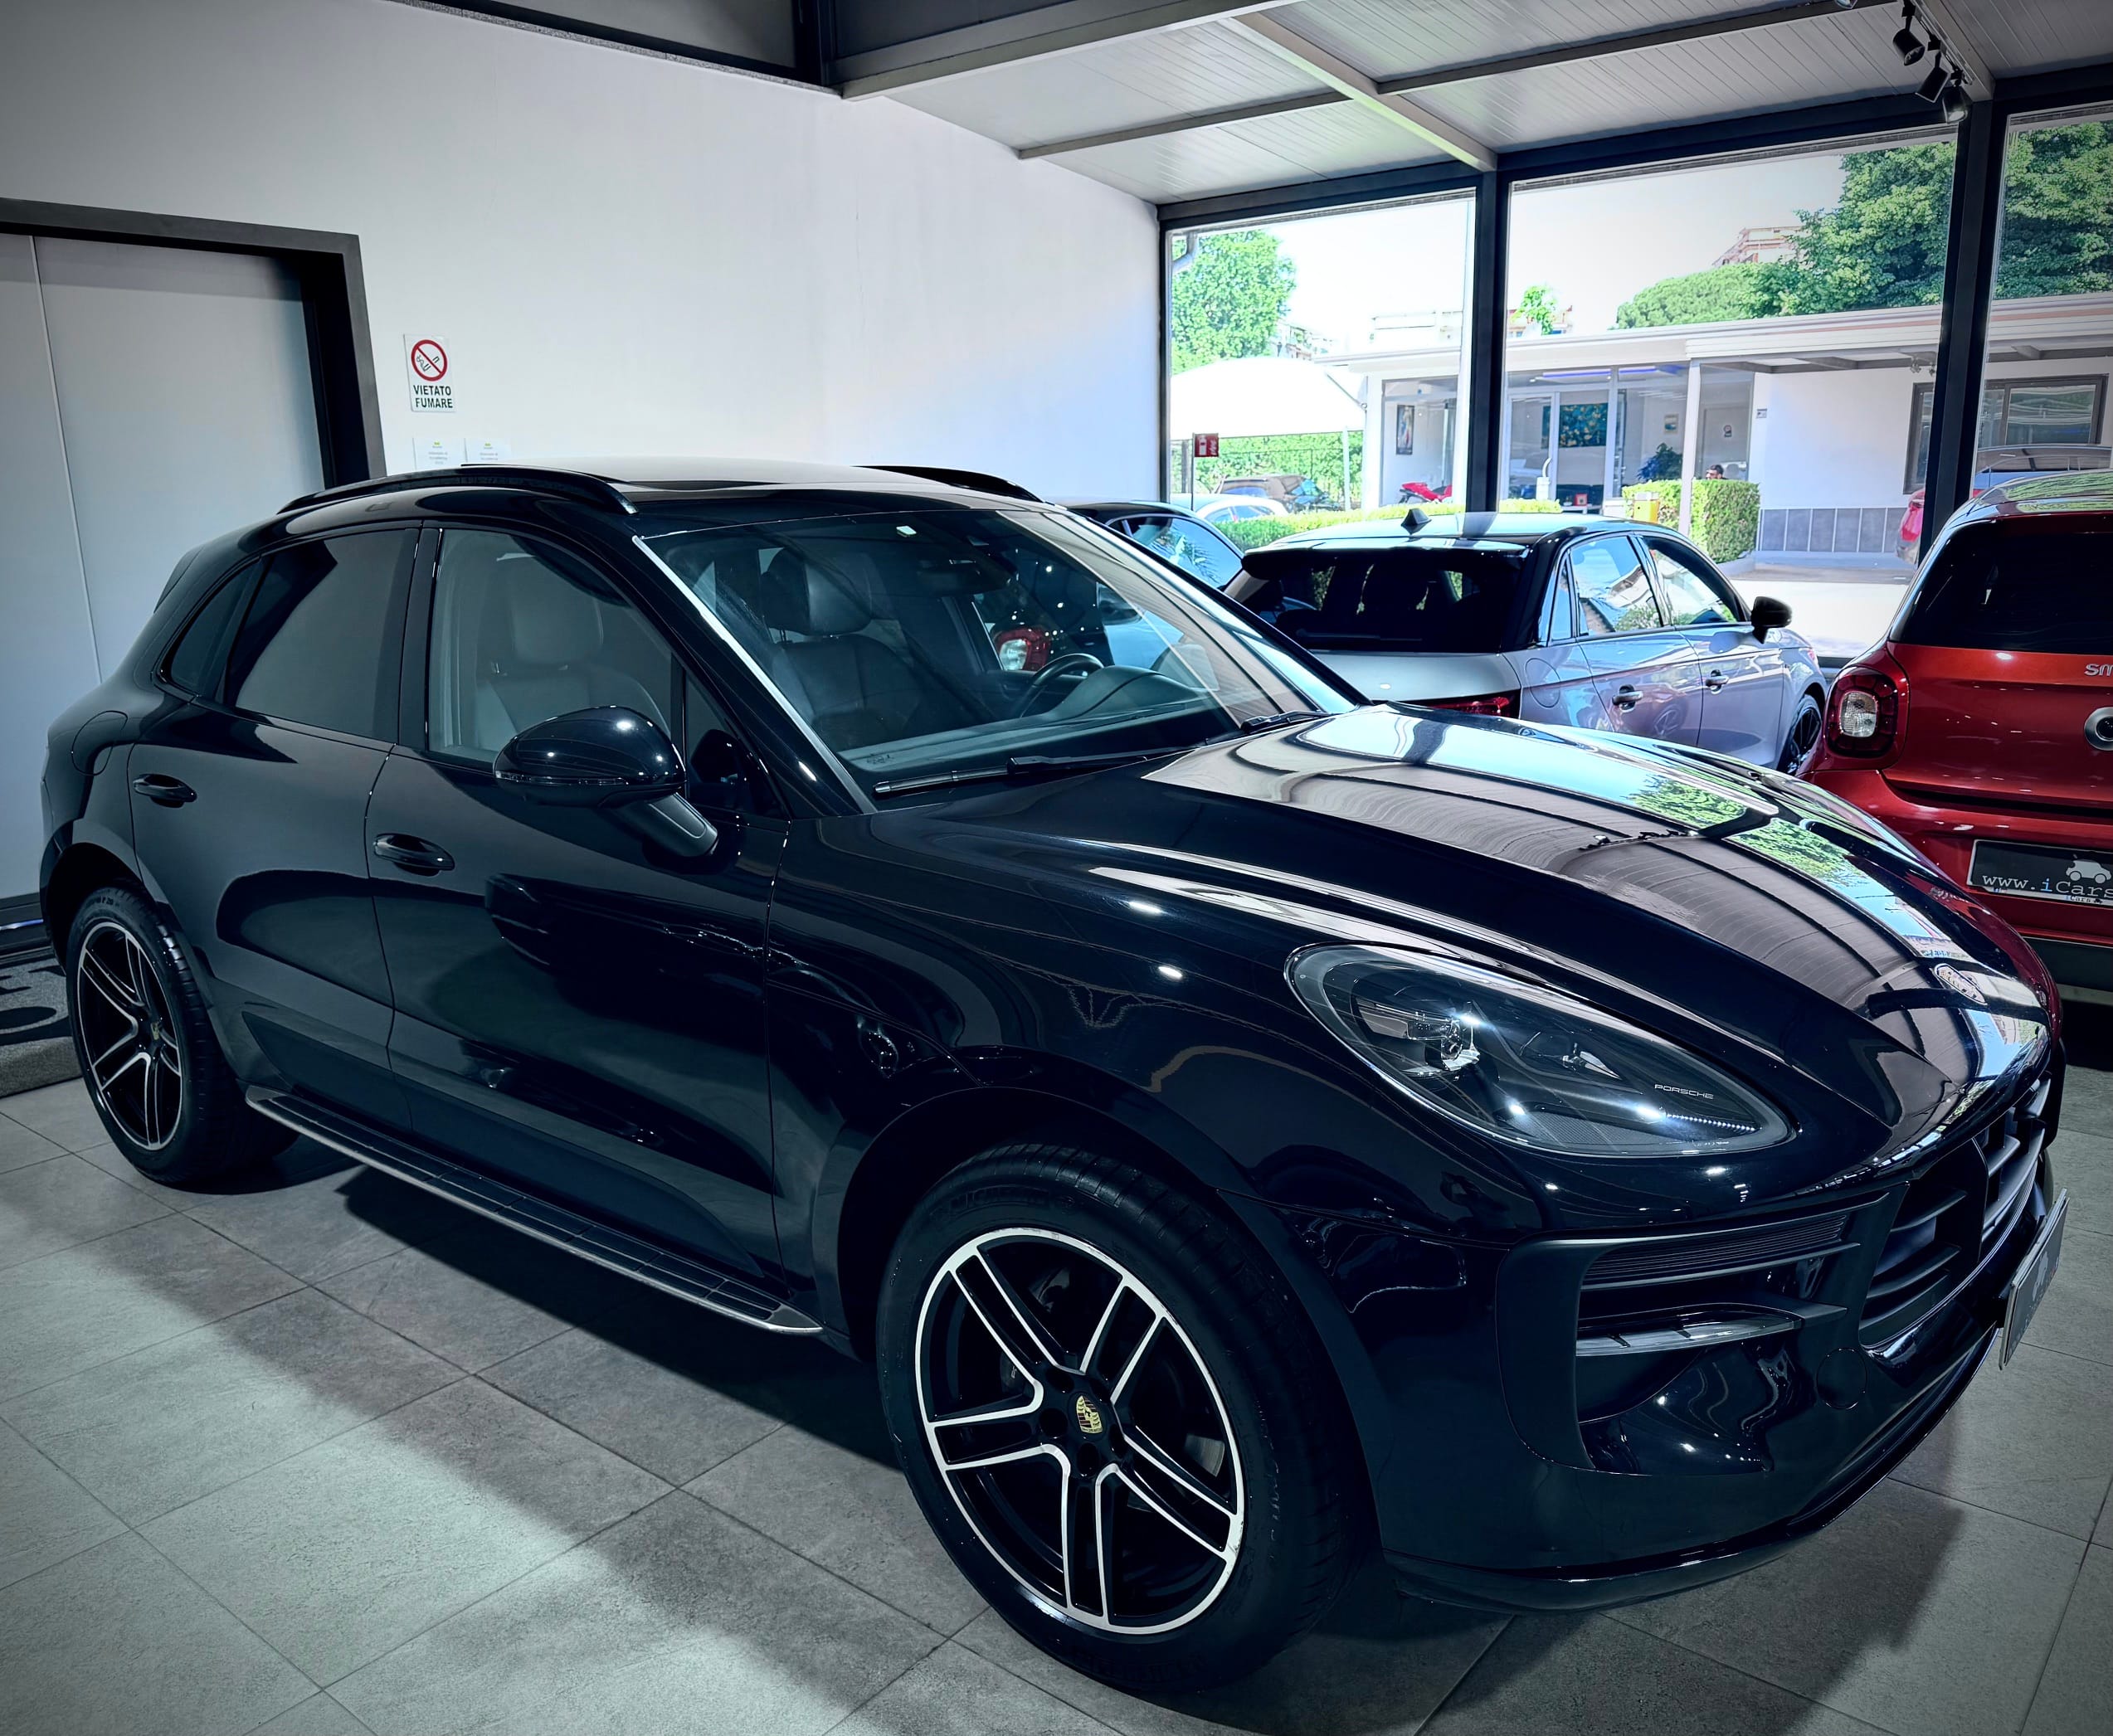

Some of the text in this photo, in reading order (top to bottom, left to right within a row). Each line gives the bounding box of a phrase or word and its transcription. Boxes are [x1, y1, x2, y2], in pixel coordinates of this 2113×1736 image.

[413, 385, 451, 396] VIETATO
[416, 397, 453, 408] FUMARE
[1654, 1084, 1714, 1099] PORSCHE
